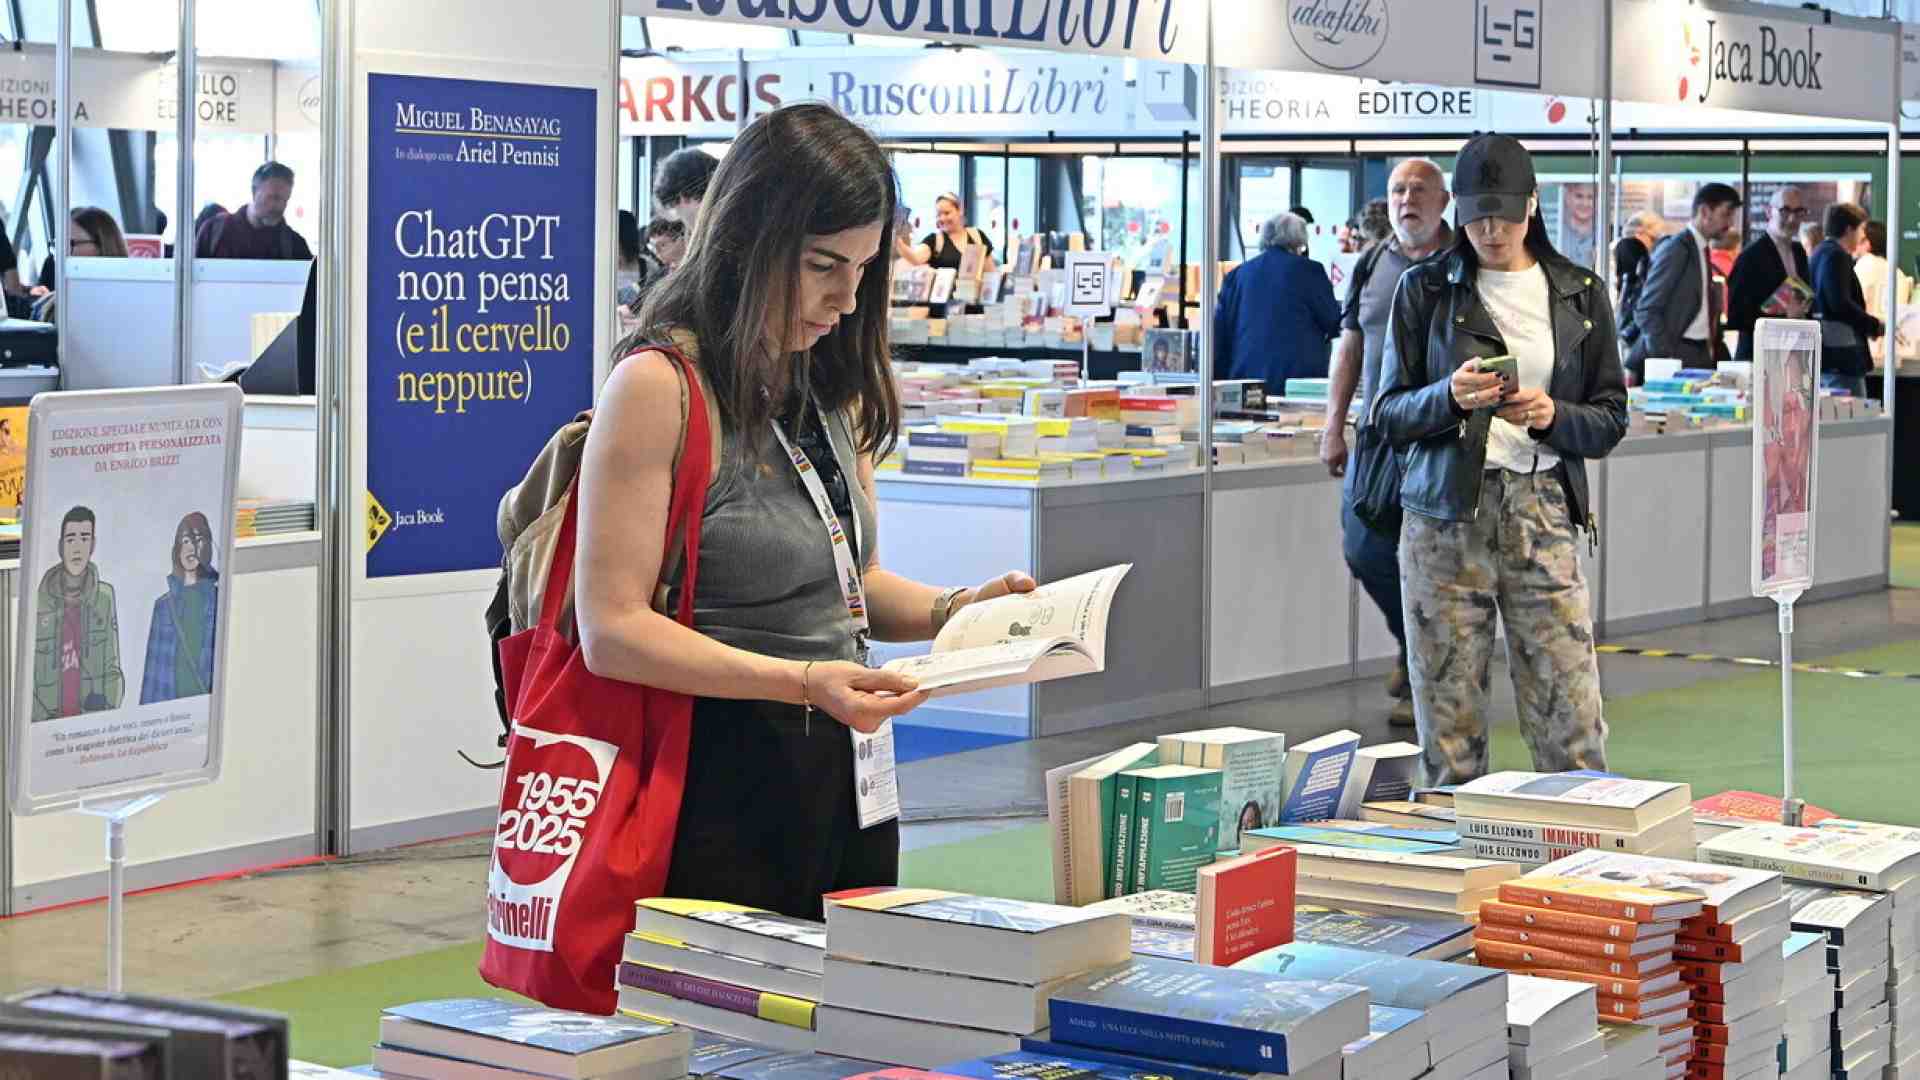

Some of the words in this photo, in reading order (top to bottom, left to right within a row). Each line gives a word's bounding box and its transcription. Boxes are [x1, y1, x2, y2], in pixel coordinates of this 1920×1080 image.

[1699, 20, 1753, 103] Jaca
[1758, 27, 1822, 91] Book
[827, 67, 1108, 116] RusconiLibri
[1359, 91, 1472, 115] EDITORE
[395, 103, 465, 130] MIGUEL
[470, 108, 561, 136] BENASAYAG
[1220, 99, 1330, 119] HEORIA
[456, 140, 497, 164] Ariel
[502, 142, 559, 167] Pennisi
[395, 209, 560, 260] ChatGPT
[397, 269, 466, 301] non
[478, 270, 571, 313] pensa
[396, 311, 424, 359] (e
[430, 304, 449, 352] il
[456, 304, 570, 353] cervello
[397, 359, 532, 414] neppure)
[203, 415, 224, 429] CON
[139, 434, 222, 451] PERSONALIZZATA
[95, 461, 107, 473] DA
[393, 511, 416, 530] Jaca
[417, 508, 444, 523] Book
[516, 771, 601, 818] 1955
[499, 809, 586, 856] 2025
[1470, 822, 1490, 835] LUIS
[1491, 824, 1534, 840] ELIZONDO
[1542, 826, 1600, 848] IMMINENT
[1474, 843, 1494, 856] LUIS
[1496, 845, 1540, 859] ELIZONDO
